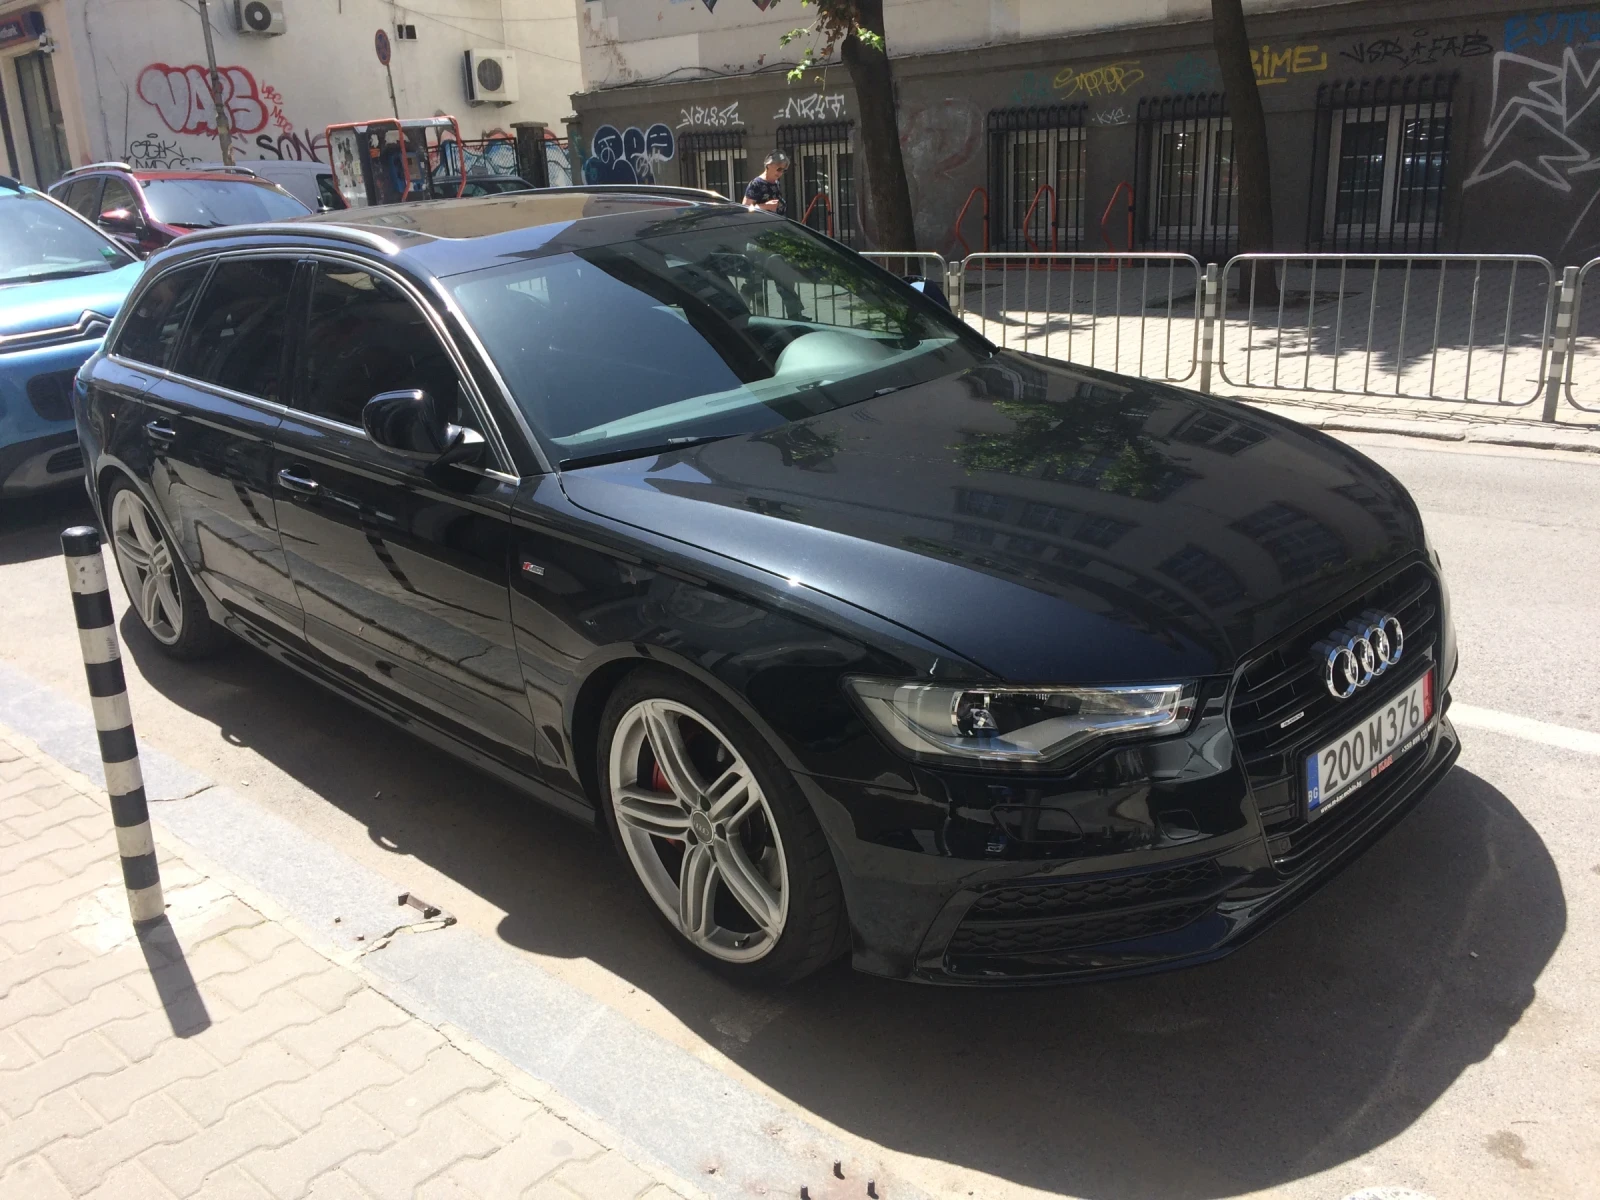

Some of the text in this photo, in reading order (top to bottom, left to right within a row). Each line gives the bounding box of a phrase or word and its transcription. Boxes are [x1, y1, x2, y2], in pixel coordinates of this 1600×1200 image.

[1323, 730, 1365, 795] 200
[1369, 715, 1382, 762] M
[1386, 688, 1420, 748] 376
[1308, 787, 1319, 803] BG
